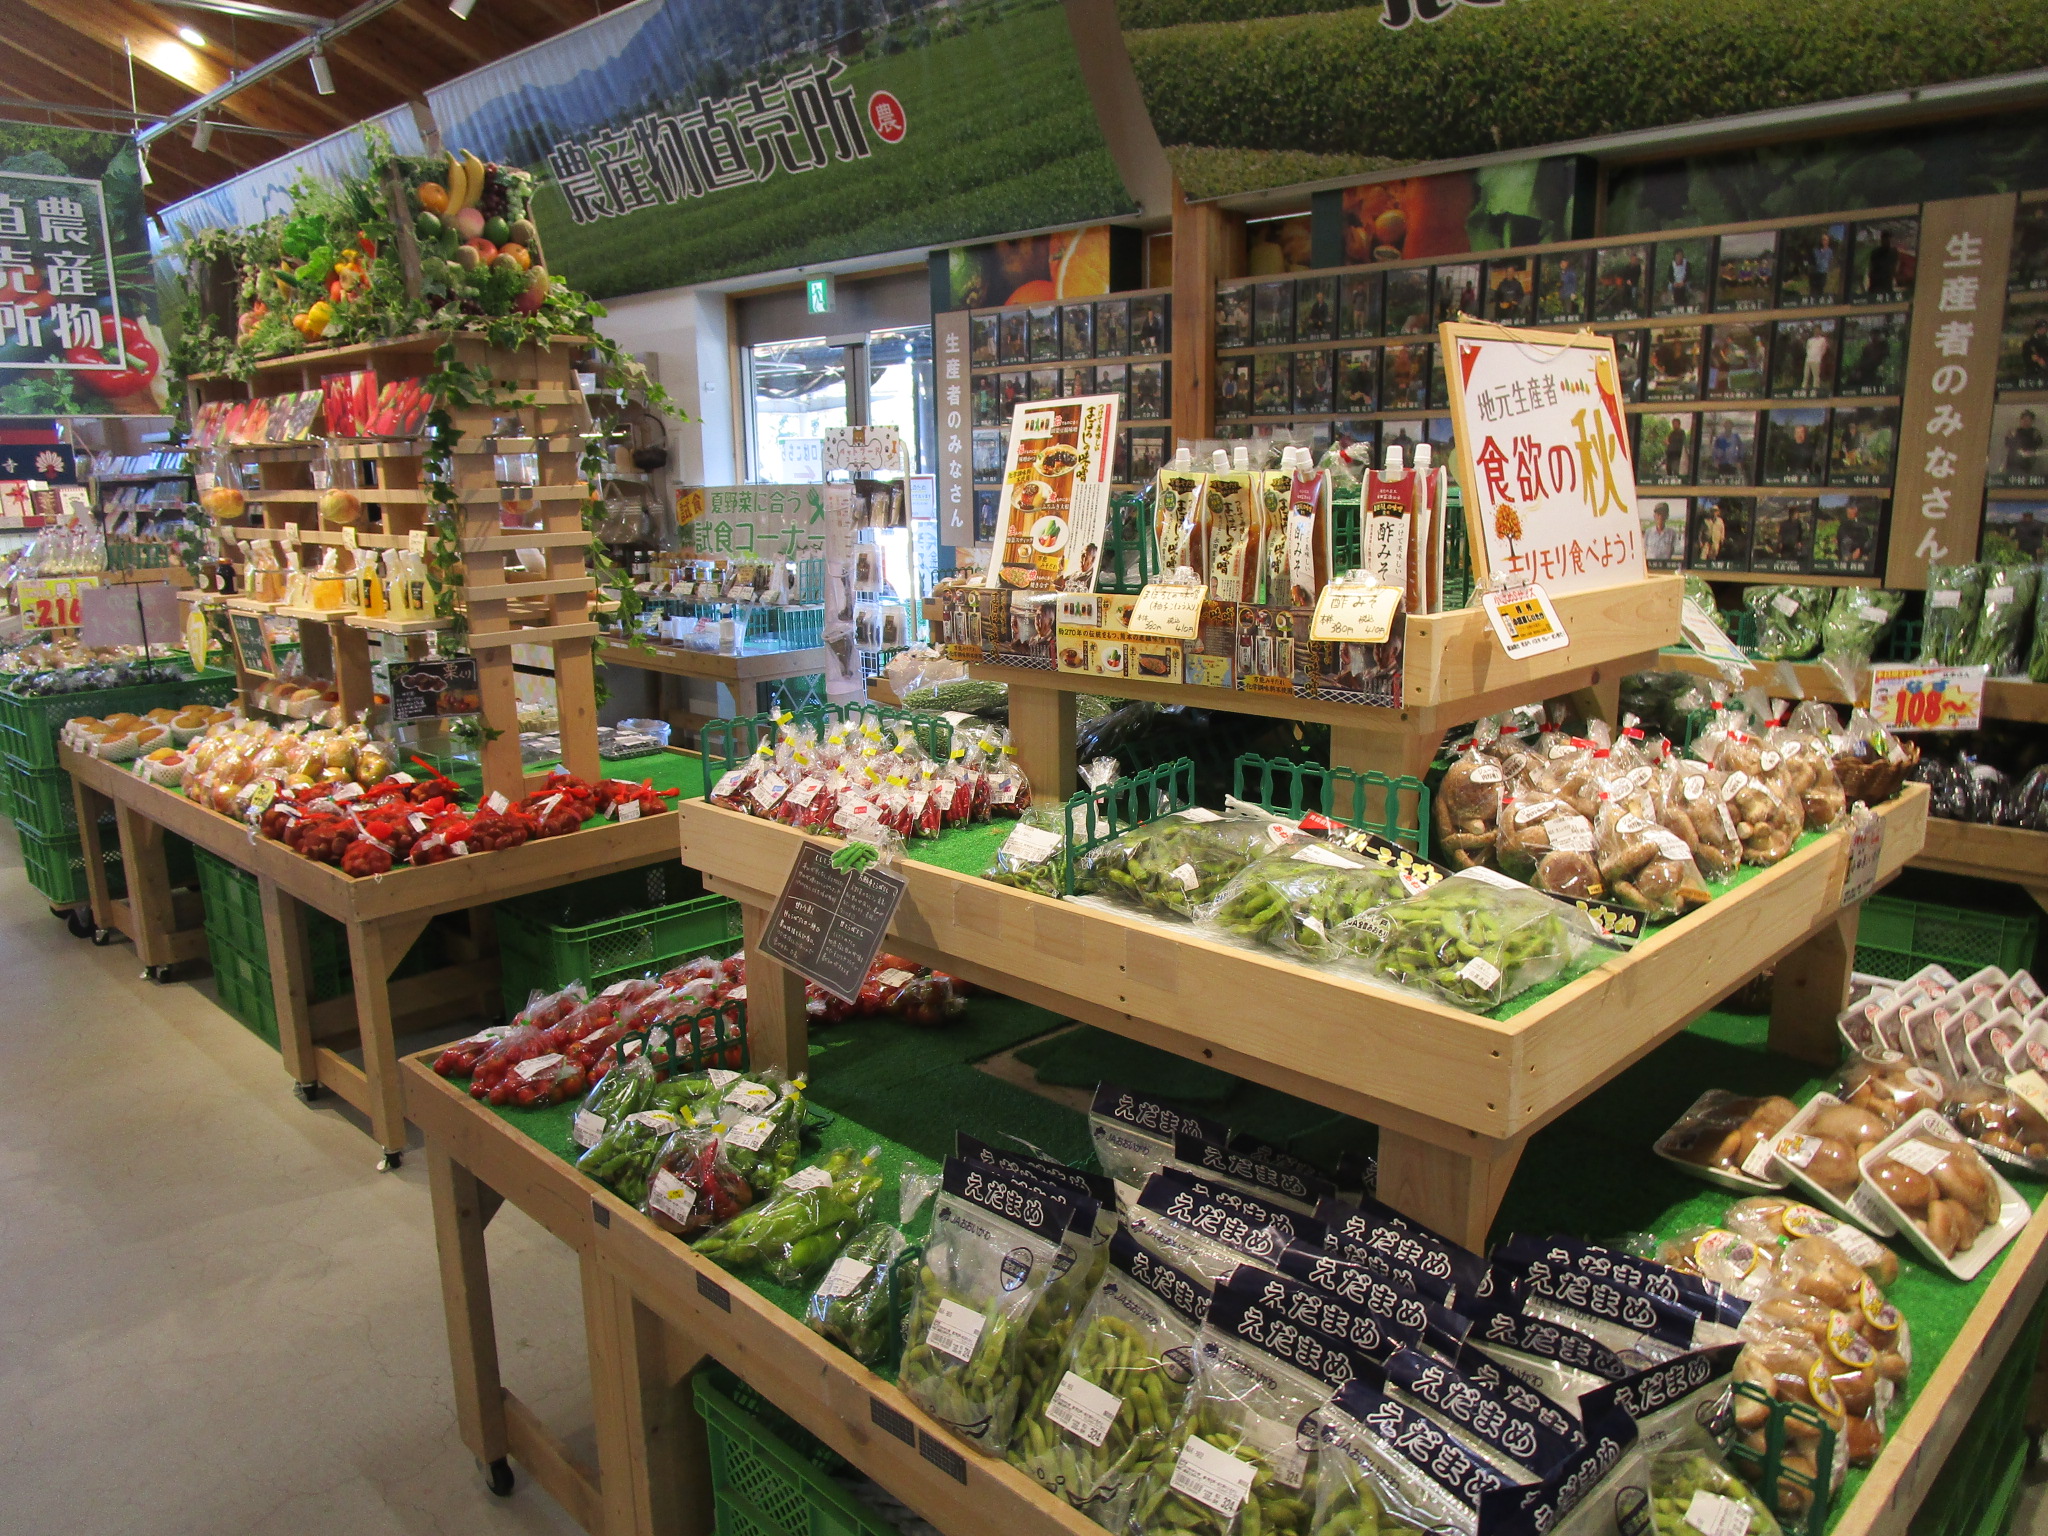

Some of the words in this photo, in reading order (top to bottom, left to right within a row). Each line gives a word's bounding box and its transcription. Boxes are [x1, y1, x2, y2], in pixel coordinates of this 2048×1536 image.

[547, 55, 872, 225] 農産物直売所
[876, 103, 902, 134] 農
[37, 196, 104, 350] 農産物
[1477, 374, 1559, 423] 地元生産者
[1914, 231, 1983, 562] 生産者のみなさん
[945, 333, 964, 528] 生産者のみなさん
[1476, 408, 1629, 518] 食欲の秋
[711, 490, 802, 514] 夏野菜に合う
[694, 520, 826, 556] 試食コーナー
[1377, 521, 1395, 581] 酢みそ
[1114, 1094, 1203, 1139] えだまめ
[964, 1171, 1045, 1227] えだまめ
[1202, 1146, 1307, 1197] えだまめ
[950, 1214, 993, 1242] JAおおいがわ
[1166, 1192, 1275, 1256] えだまめ
[1340, 1215, 1452, 1280] えだまめ
[1259, 1280, 1380, 1350] えだまめ
[1309, 1256, 1428, 1332] えだまめ
[1524, 1261, 1657, 1329] えだまめ
[1238, 1306, 1354, 1385] えだまめ
[1486, 1313, 1631, 1381] えだまめ
[1087, 1427, 1102, 1442] 324
[1411, 1365, 1537, 1458] えだまめ
[1366, 1401, 1501, 1506] えだまめ
[1220, 1497, 1236, 1513] 324
